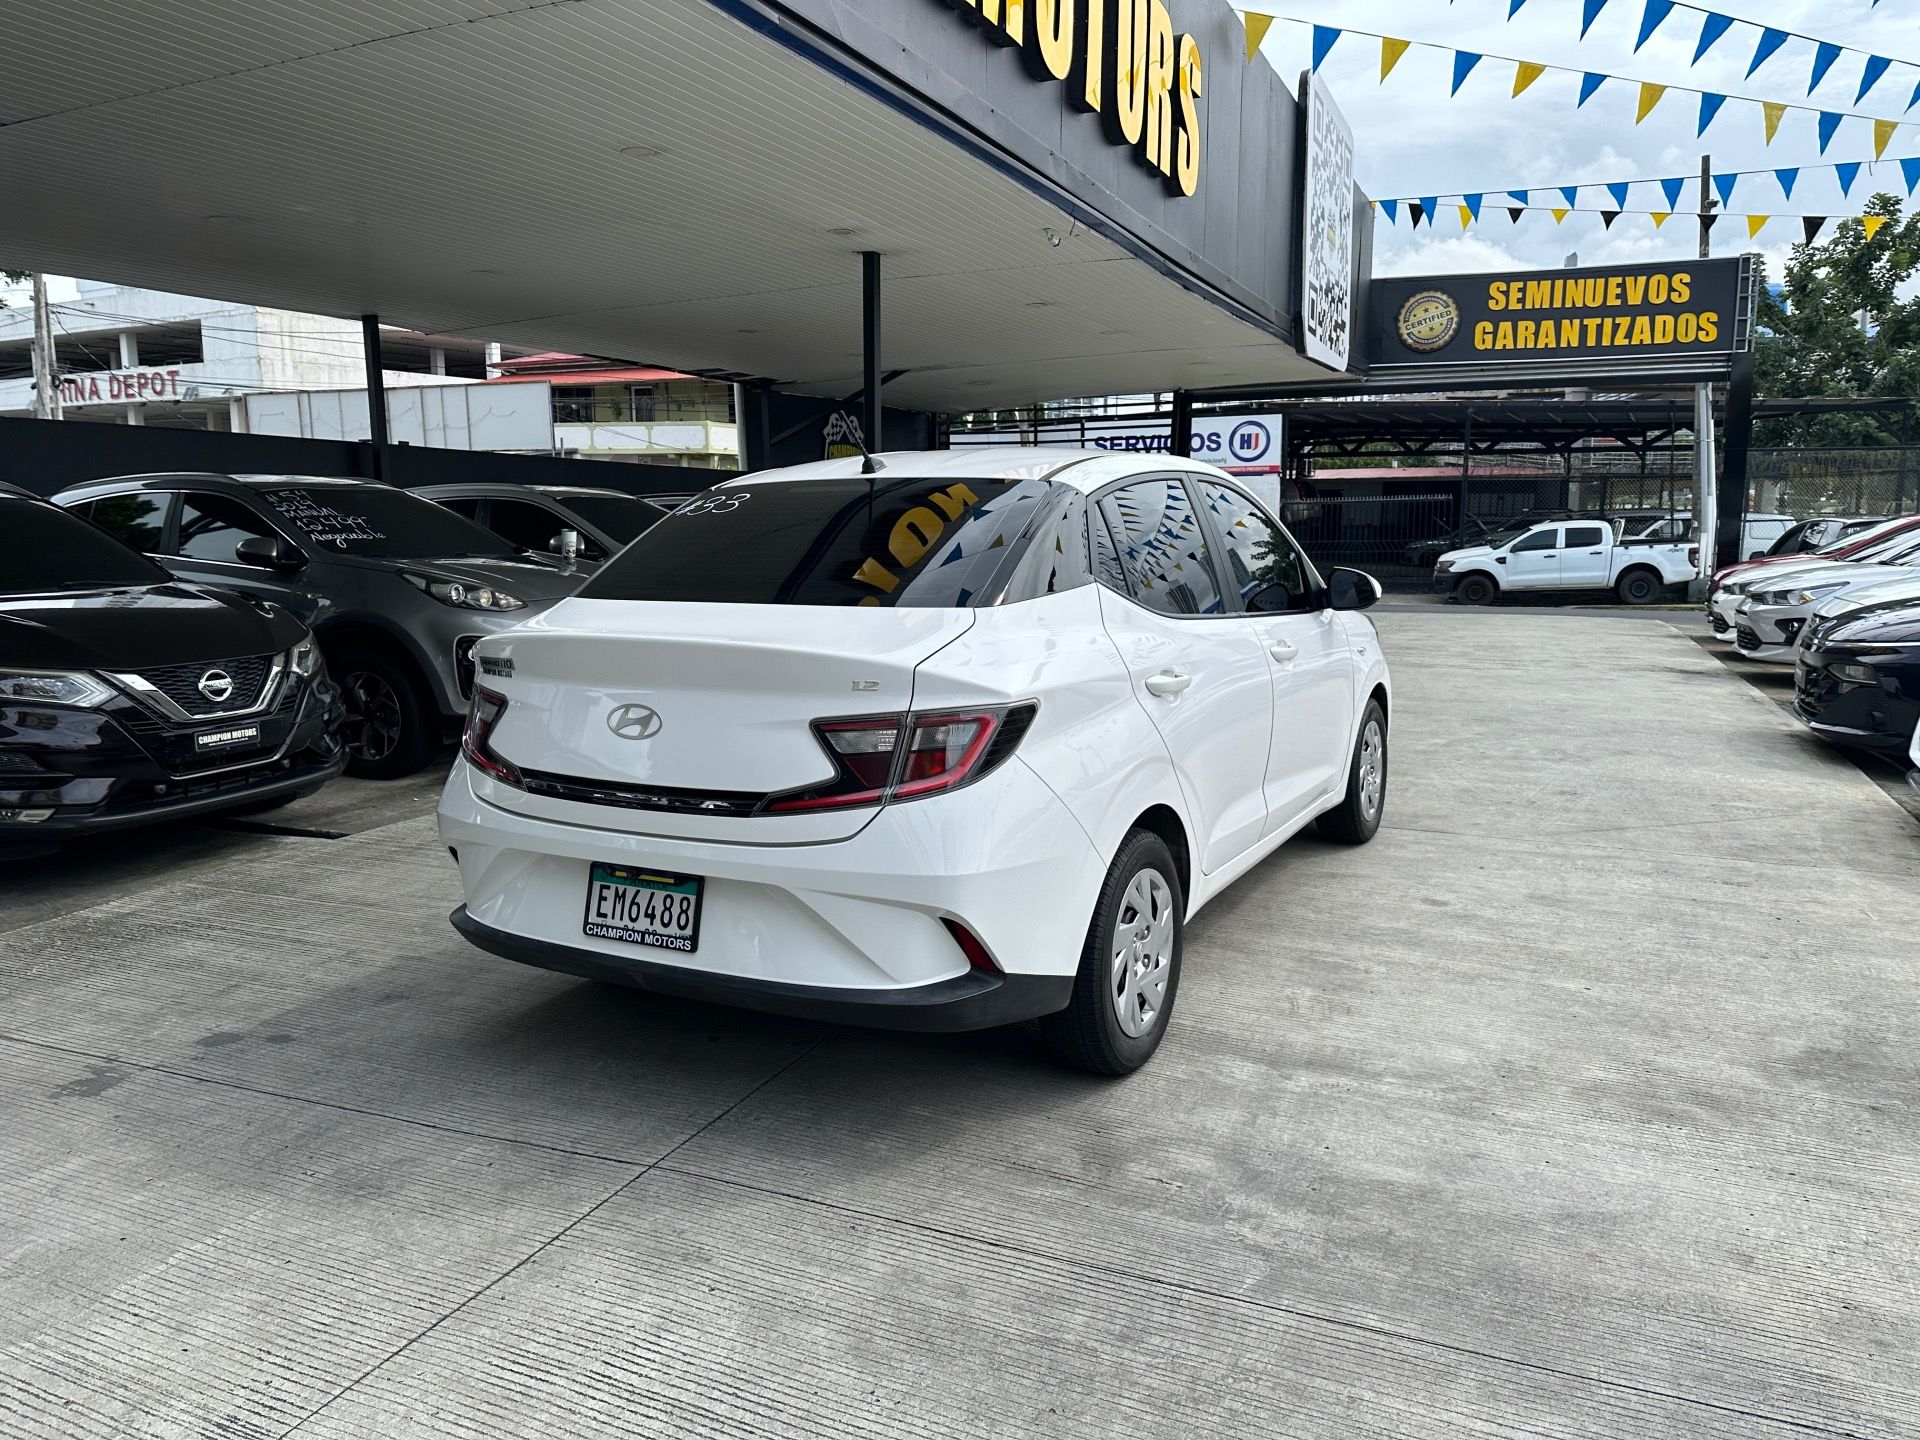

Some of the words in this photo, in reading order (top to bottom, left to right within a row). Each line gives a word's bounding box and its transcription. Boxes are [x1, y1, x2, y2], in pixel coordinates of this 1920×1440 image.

[1488, 273, 1691, 311] SEMINUEVOS
[1405, 309, 1452, 331] CERTIFIED
[1474, 312, 1719, 350] GARANTIZADOS
[109, 370, 180, 400] DEPOT
[828, 444, 863, 458] CHAMPIO
[1094, 432, 1222, 453] SERVIOS
[282, 507, 345, 518] MANUAL
[674, 493, 751, 516] #33
[198, 731, 232, 745] CHAMPION
[231, 727, 257, 741] MOTORS
[596, 883, 691, 931] EM6488
[586, 924, 642, 943] CHAMPION
[644, 931, 692, 951] MOTORS
